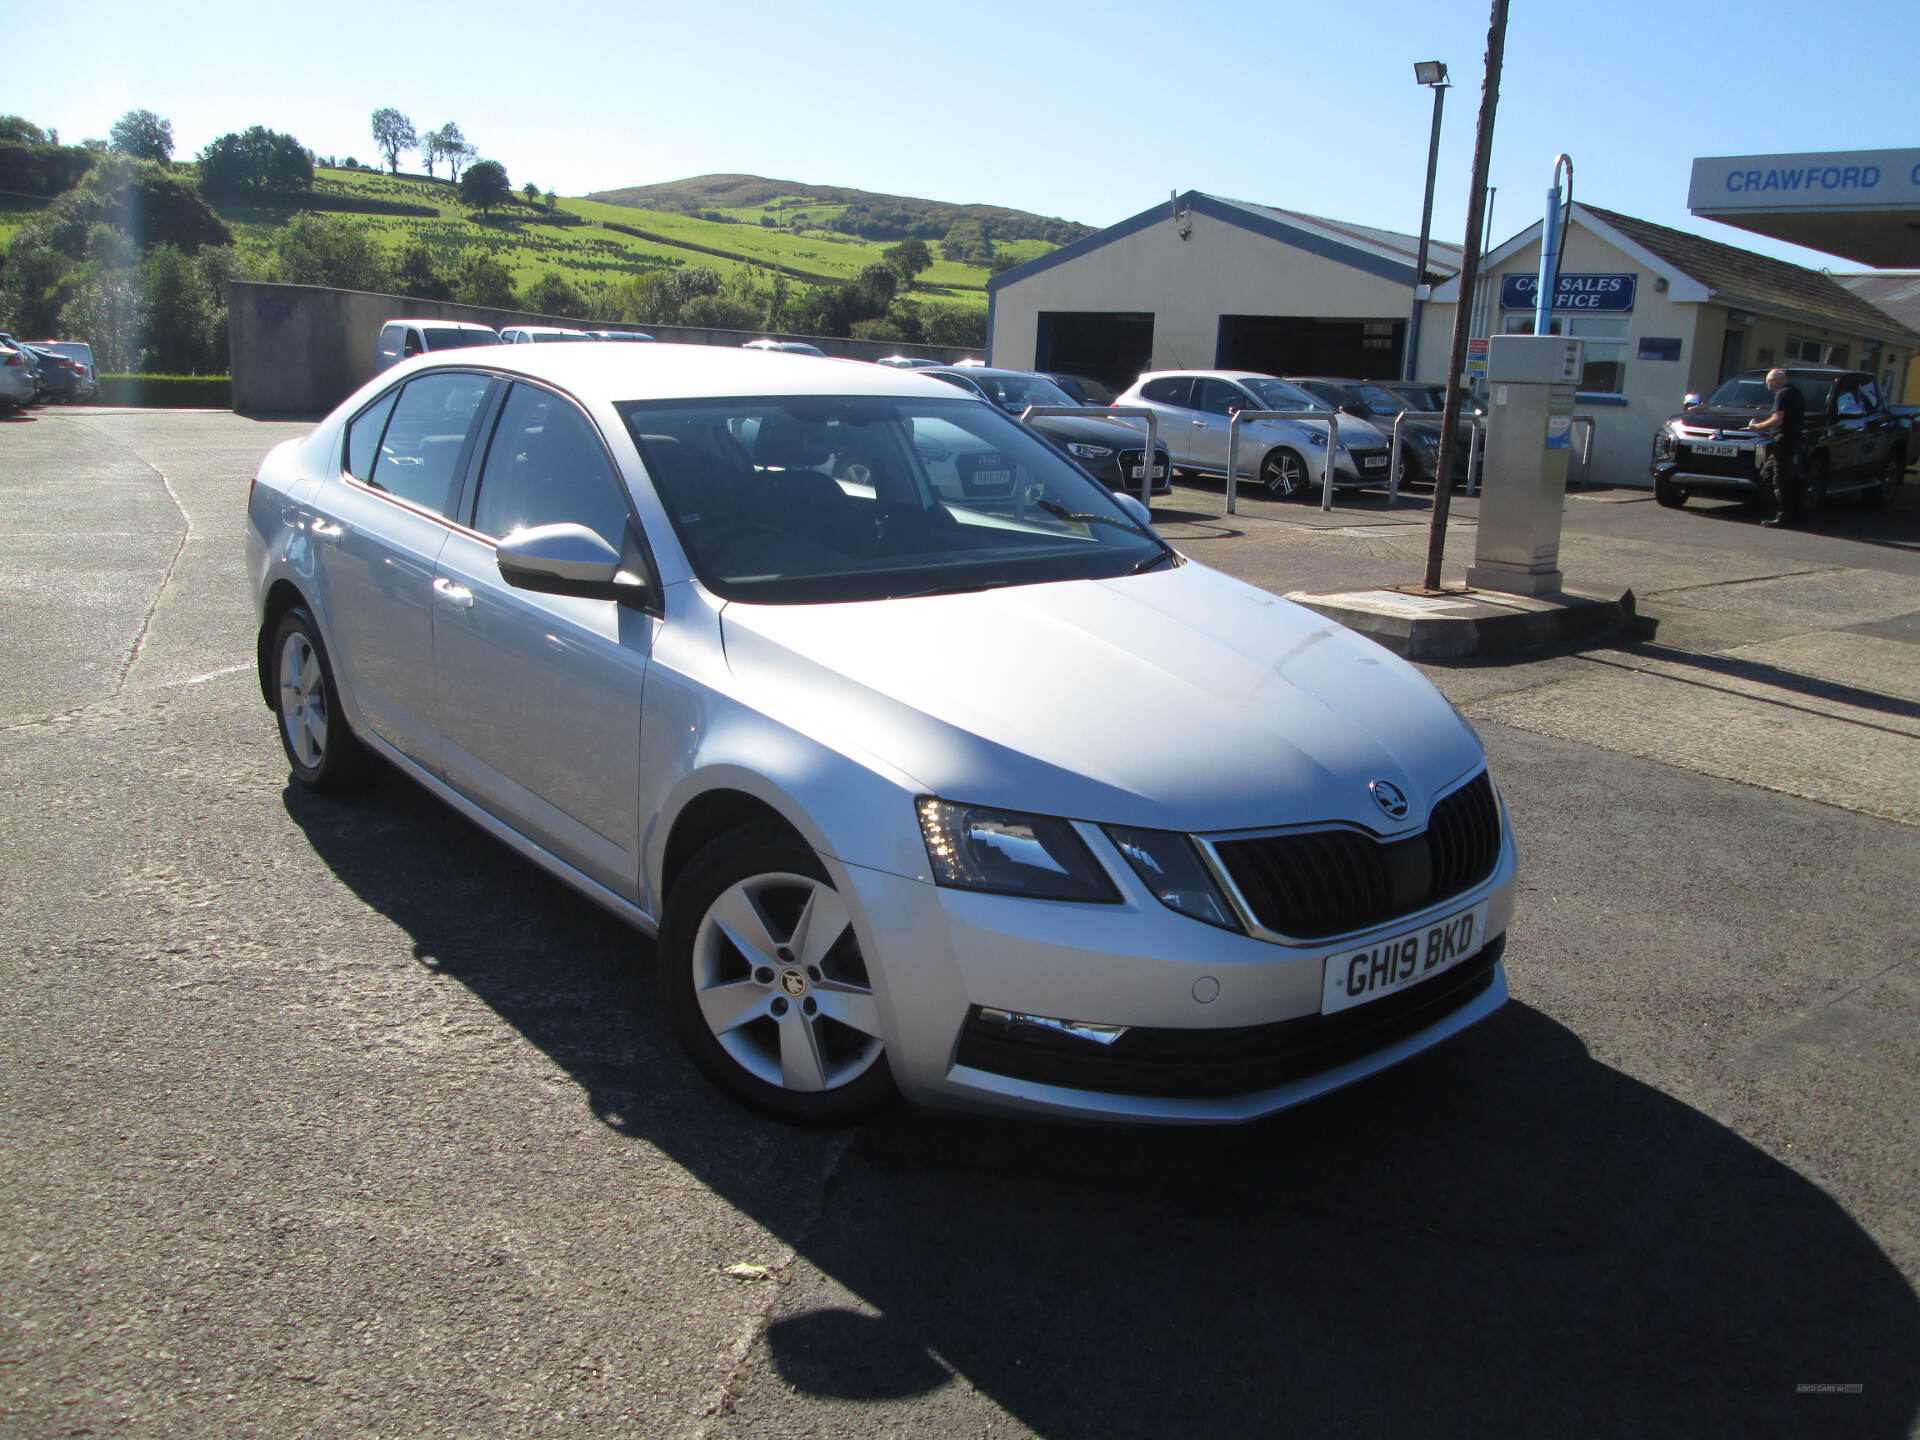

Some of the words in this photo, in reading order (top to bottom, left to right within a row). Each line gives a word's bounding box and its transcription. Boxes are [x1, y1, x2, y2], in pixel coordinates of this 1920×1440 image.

[1726, 166, 1880, 192] CRAWFORD
[1515, 278, 1540, 291] CA
[1560, 278, 1621, 291] SALES
[1347, 938, 1418, 997] GH19
[1424, 913, 1473, 971] BKD
